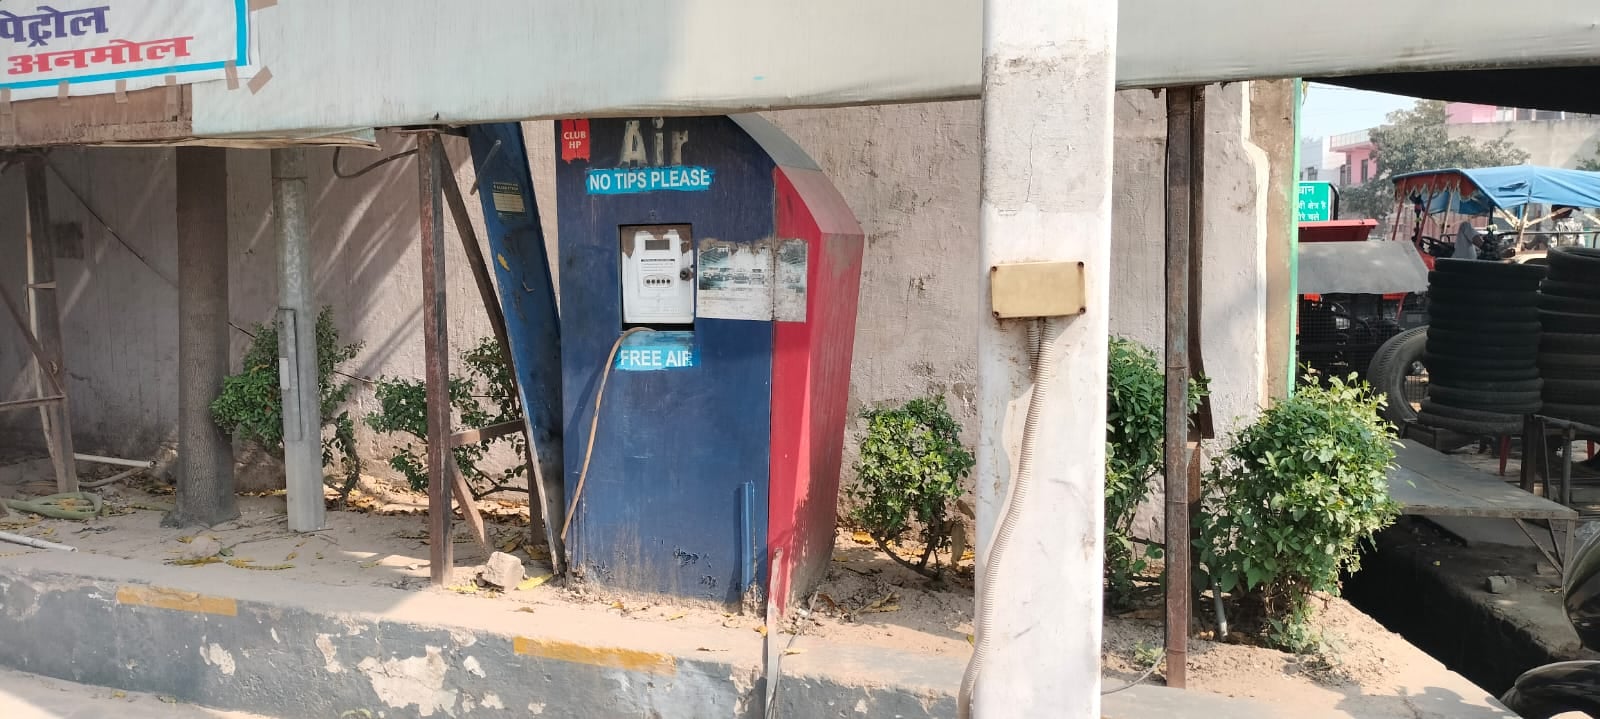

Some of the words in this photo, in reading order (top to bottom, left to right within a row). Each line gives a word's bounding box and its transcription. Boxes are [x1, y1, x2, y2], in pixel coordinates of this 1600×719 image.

[0, 5, 110, 48] पेट्रोल
[7, 36, 194, 76] अनमोल
[563, 131, 587, 140] CLUB
[568, 140, 582, 149] HP
[618, 116, 689, 167] Air
[589, 173, 611, 191] NO
[614, 172, 647, 189] TIPS
[650, 169, 711, 188] PLEASE
[620, 349, 662, 366] FREE
[665, 350, 693, 367] AIR
